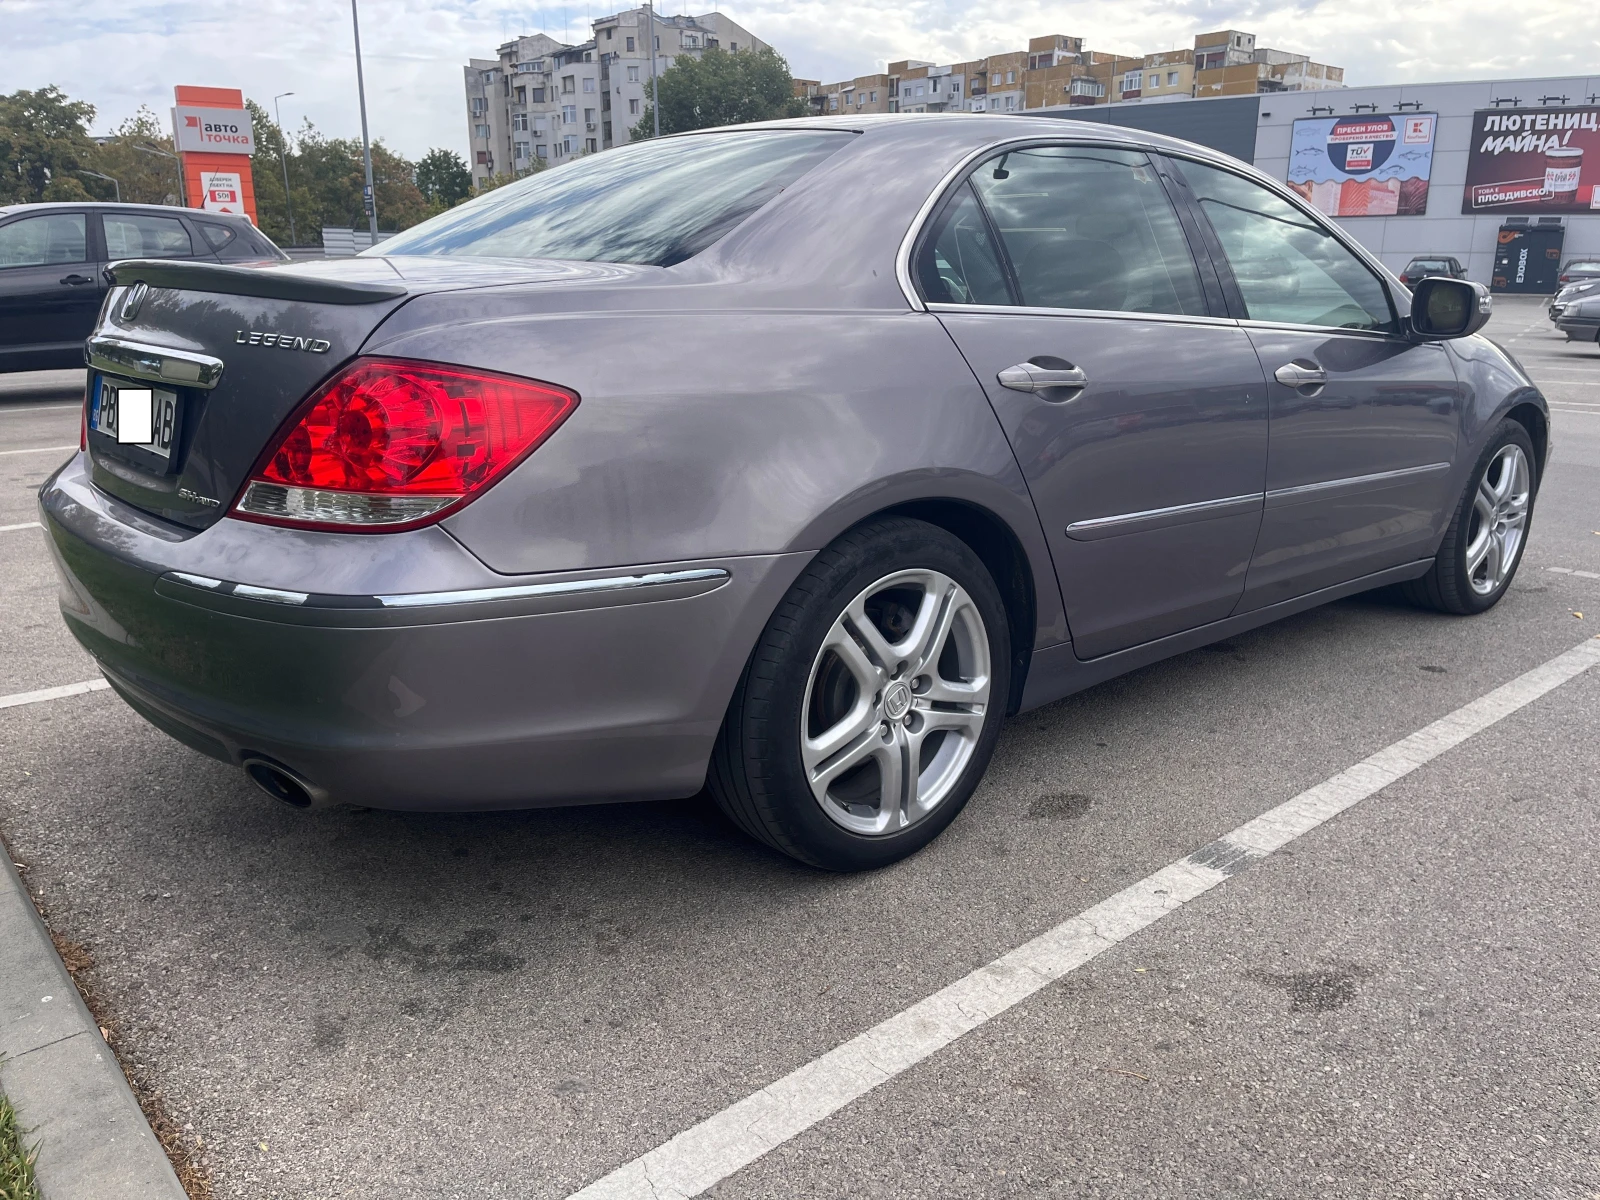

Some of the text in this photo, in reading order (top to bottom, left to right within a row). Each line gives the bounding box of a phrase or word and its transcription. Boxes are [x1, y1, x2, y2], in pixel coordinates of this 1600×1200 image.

[204, 123, 238, 133] авто
[1337, 124, 1388, 134] ПРЕСЕН УЛОВ
[1483, 113, 1600, 132] ЛЮТЕНИЦ
[206, 134, 249, 144] точка
[1480, 129, 1573, 155] МАЙНА!
[1516, 248, 1528, 283] EXOBOX
[234, 329, 331, 354] LEGEND
